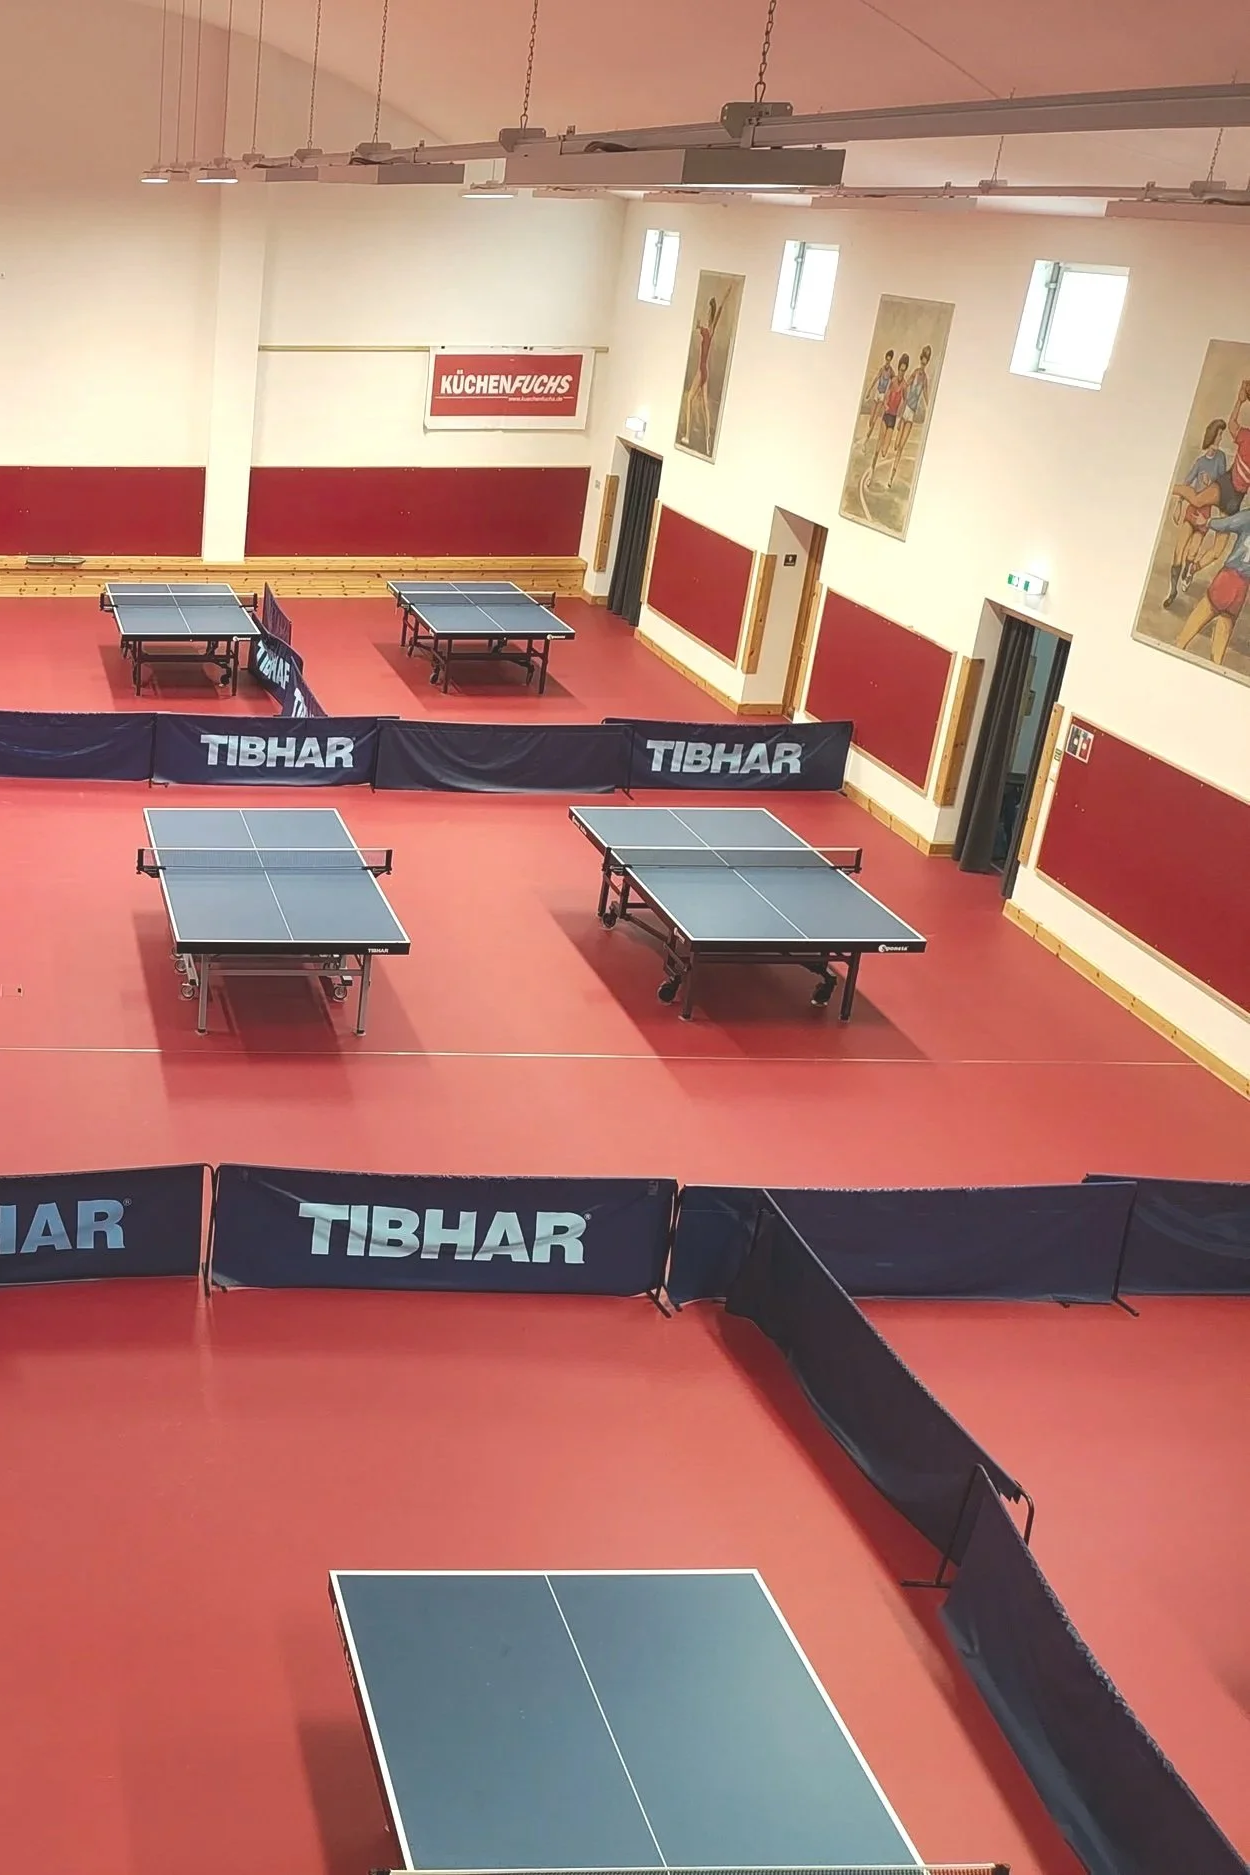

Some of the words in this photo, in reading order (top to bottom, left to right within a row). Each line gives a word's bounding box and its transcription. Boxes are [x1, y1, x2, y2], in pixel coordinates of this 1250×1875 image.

[440, 369, 573, 395] KÜCHENFUCHS
[200, 734, 355, 768] TIBHAR
[646, 739, 803, 774] TIBHAR
[298, 1201, 586, 1265] TIBHAR
